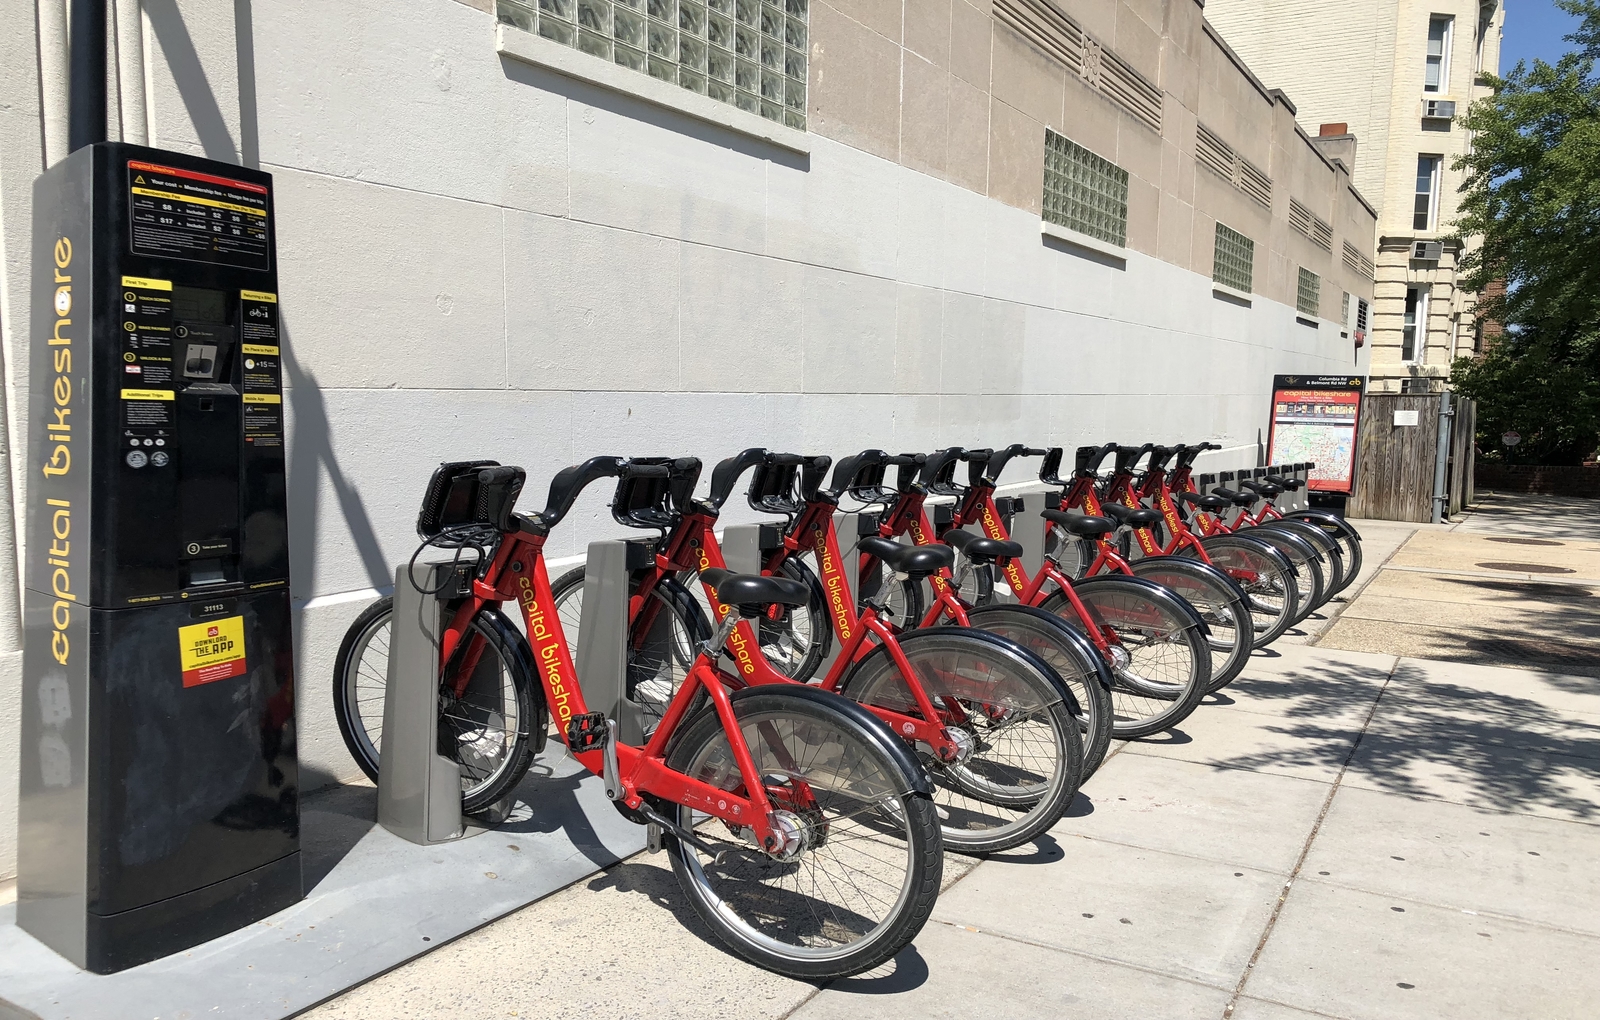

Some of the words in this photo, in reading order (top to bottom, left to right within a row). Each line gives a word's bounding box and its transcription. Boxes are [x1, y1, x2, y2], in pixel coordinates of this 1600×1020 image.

[140, 188, 170, 198] Membership
[150, 178, 164, 186] Your
[184, 184, 213, 194] Membership
[186, 222, 206, 230] Included
[42, 236, 72, 479] bikeshare
[910, 520, 929, 545] capi
[815, 530, 836, 574] capital
[47, 498, 76, 666] capital
[1007, 564, 1022, 590] share
[204, 604, 224, 612] 31113
[520, 577, 552, 641] capital
[827, 575, 851, 639] bikeshare
[195, 635, 227, 647] DOWNLOAD
[212, 640, 234, 654] APP
